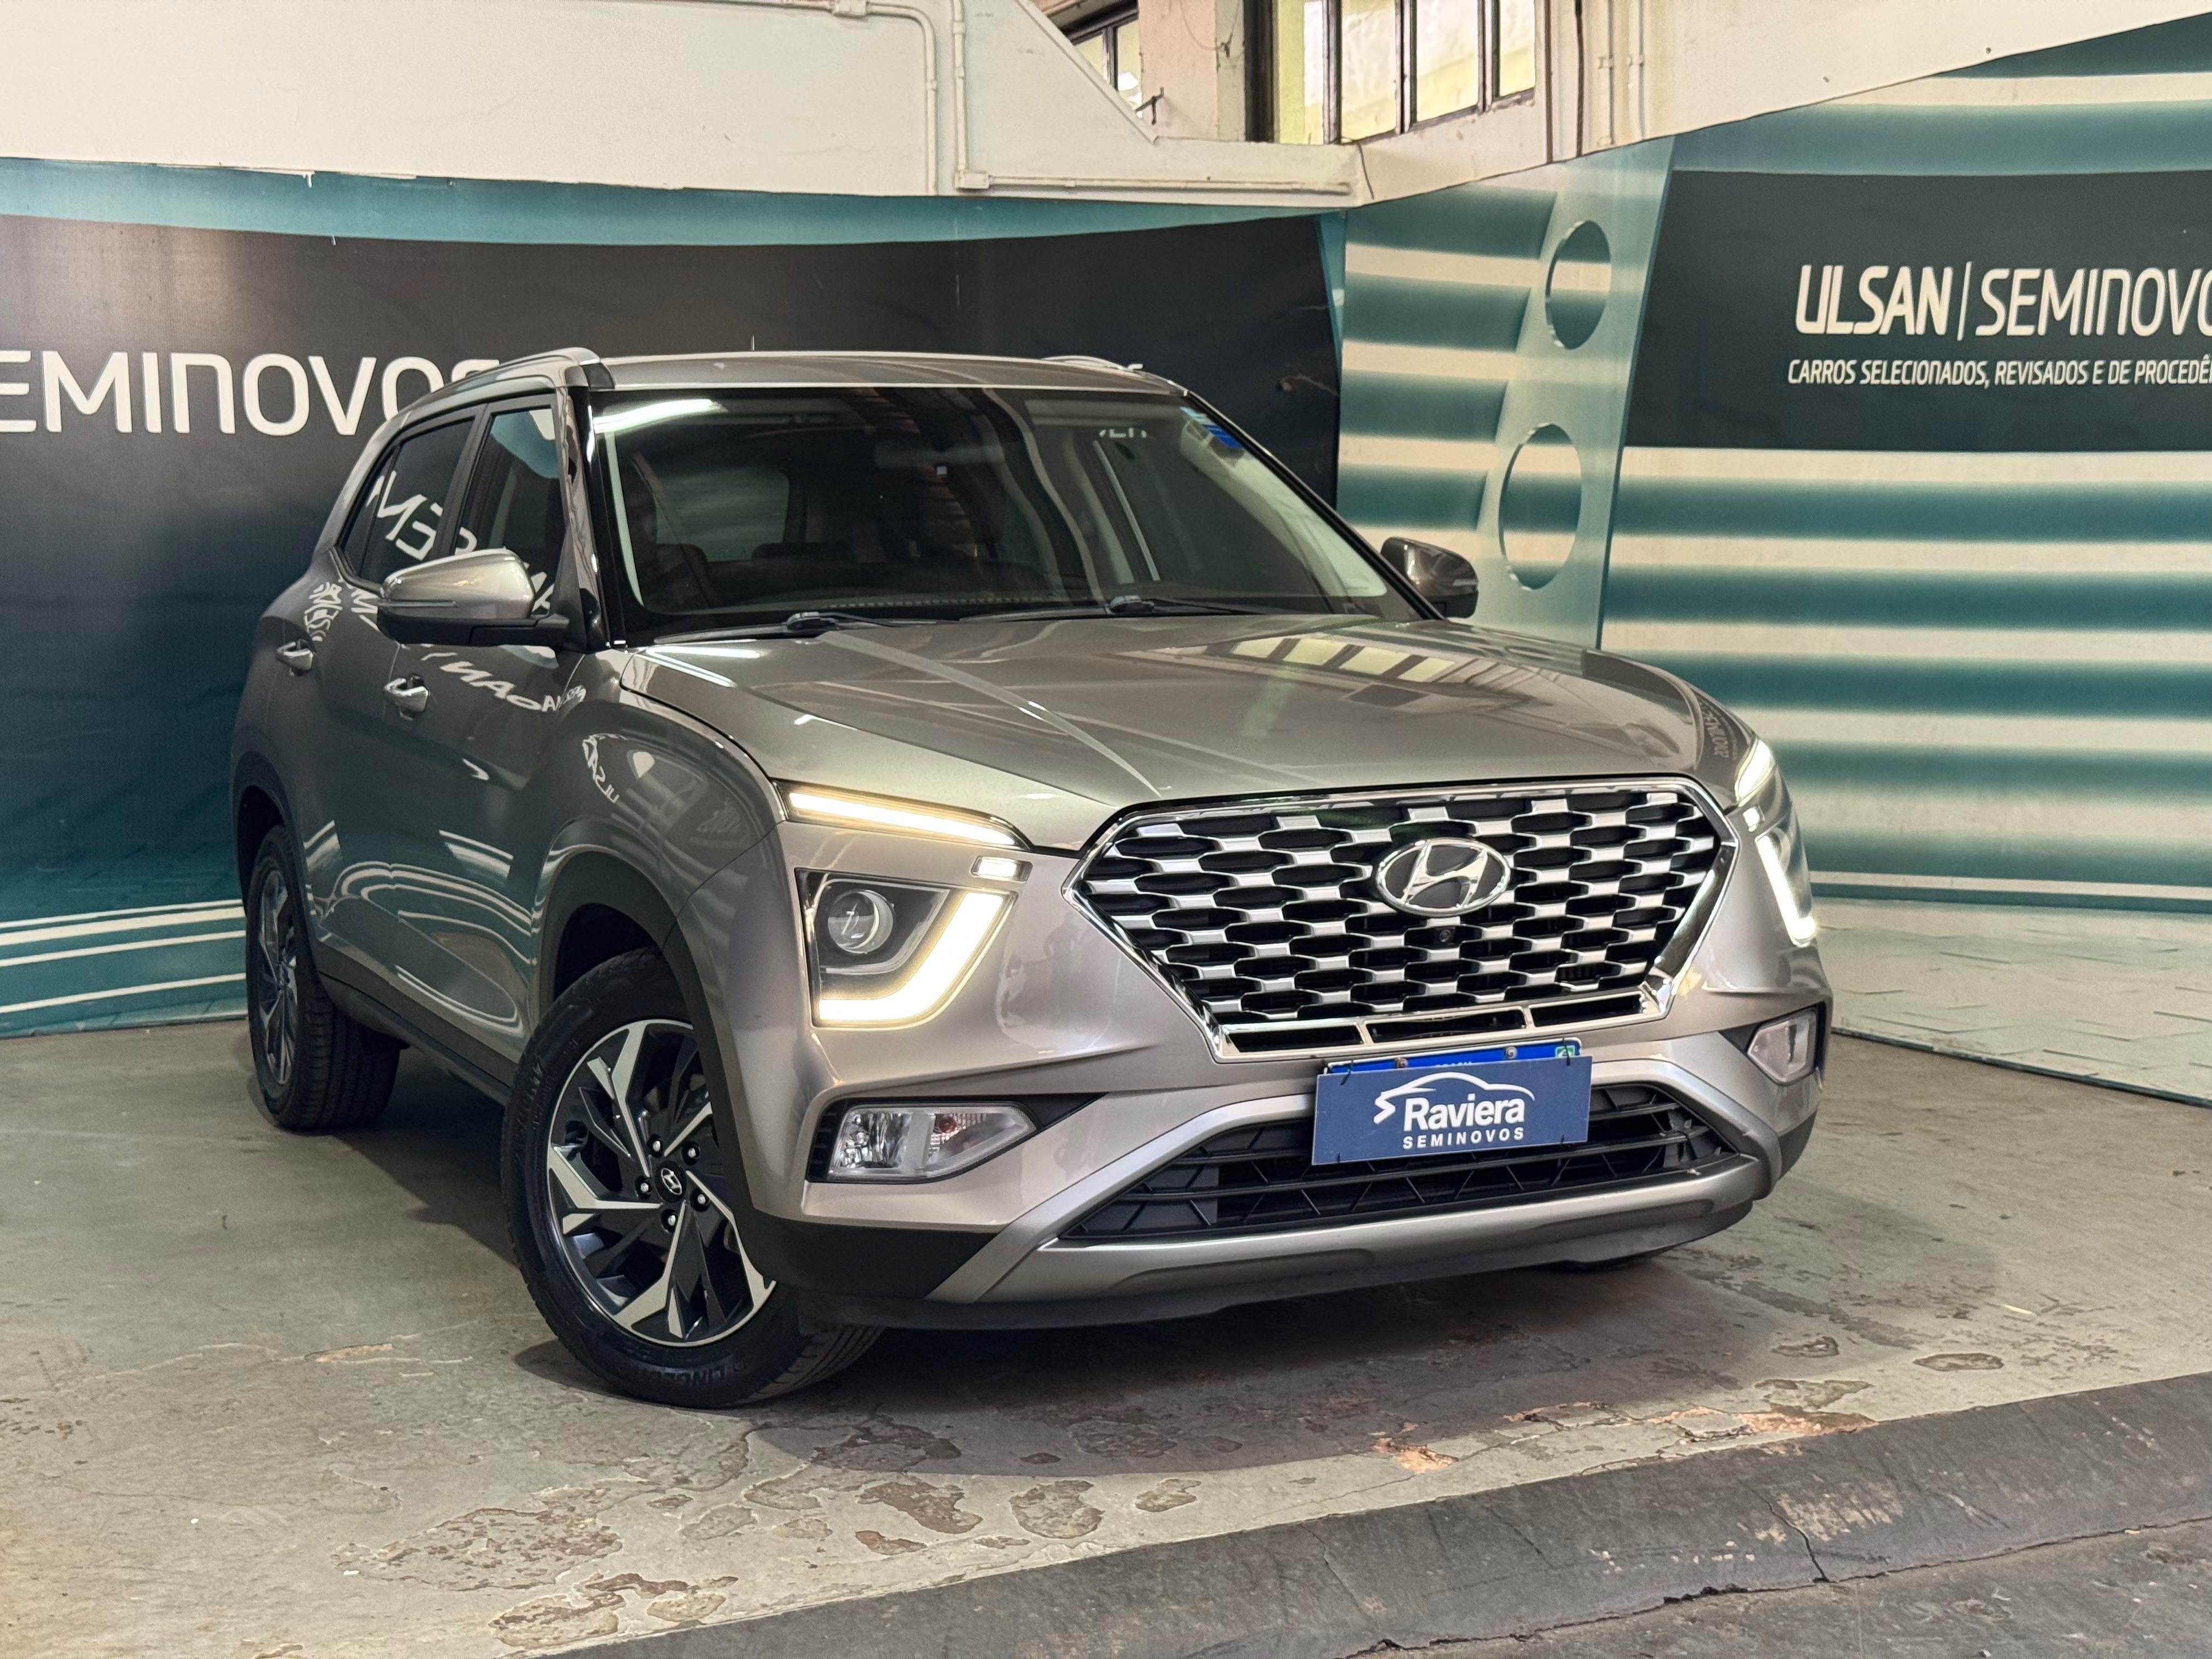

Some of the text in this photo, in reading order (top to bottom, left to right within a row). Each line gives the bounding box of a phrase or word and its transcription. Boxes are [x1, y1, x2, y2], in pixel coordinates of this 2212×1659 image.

[1796, 265, 1953, 335] ULSAN
[1788, 353, 2212, 390] CARROS SELECIONADOS, REVISADOS E DE PROCEDÊ
[1403, 1093, 1525, 1132] Raviera
[1402, 1127, 1525, 1150] SEMINOVOS
